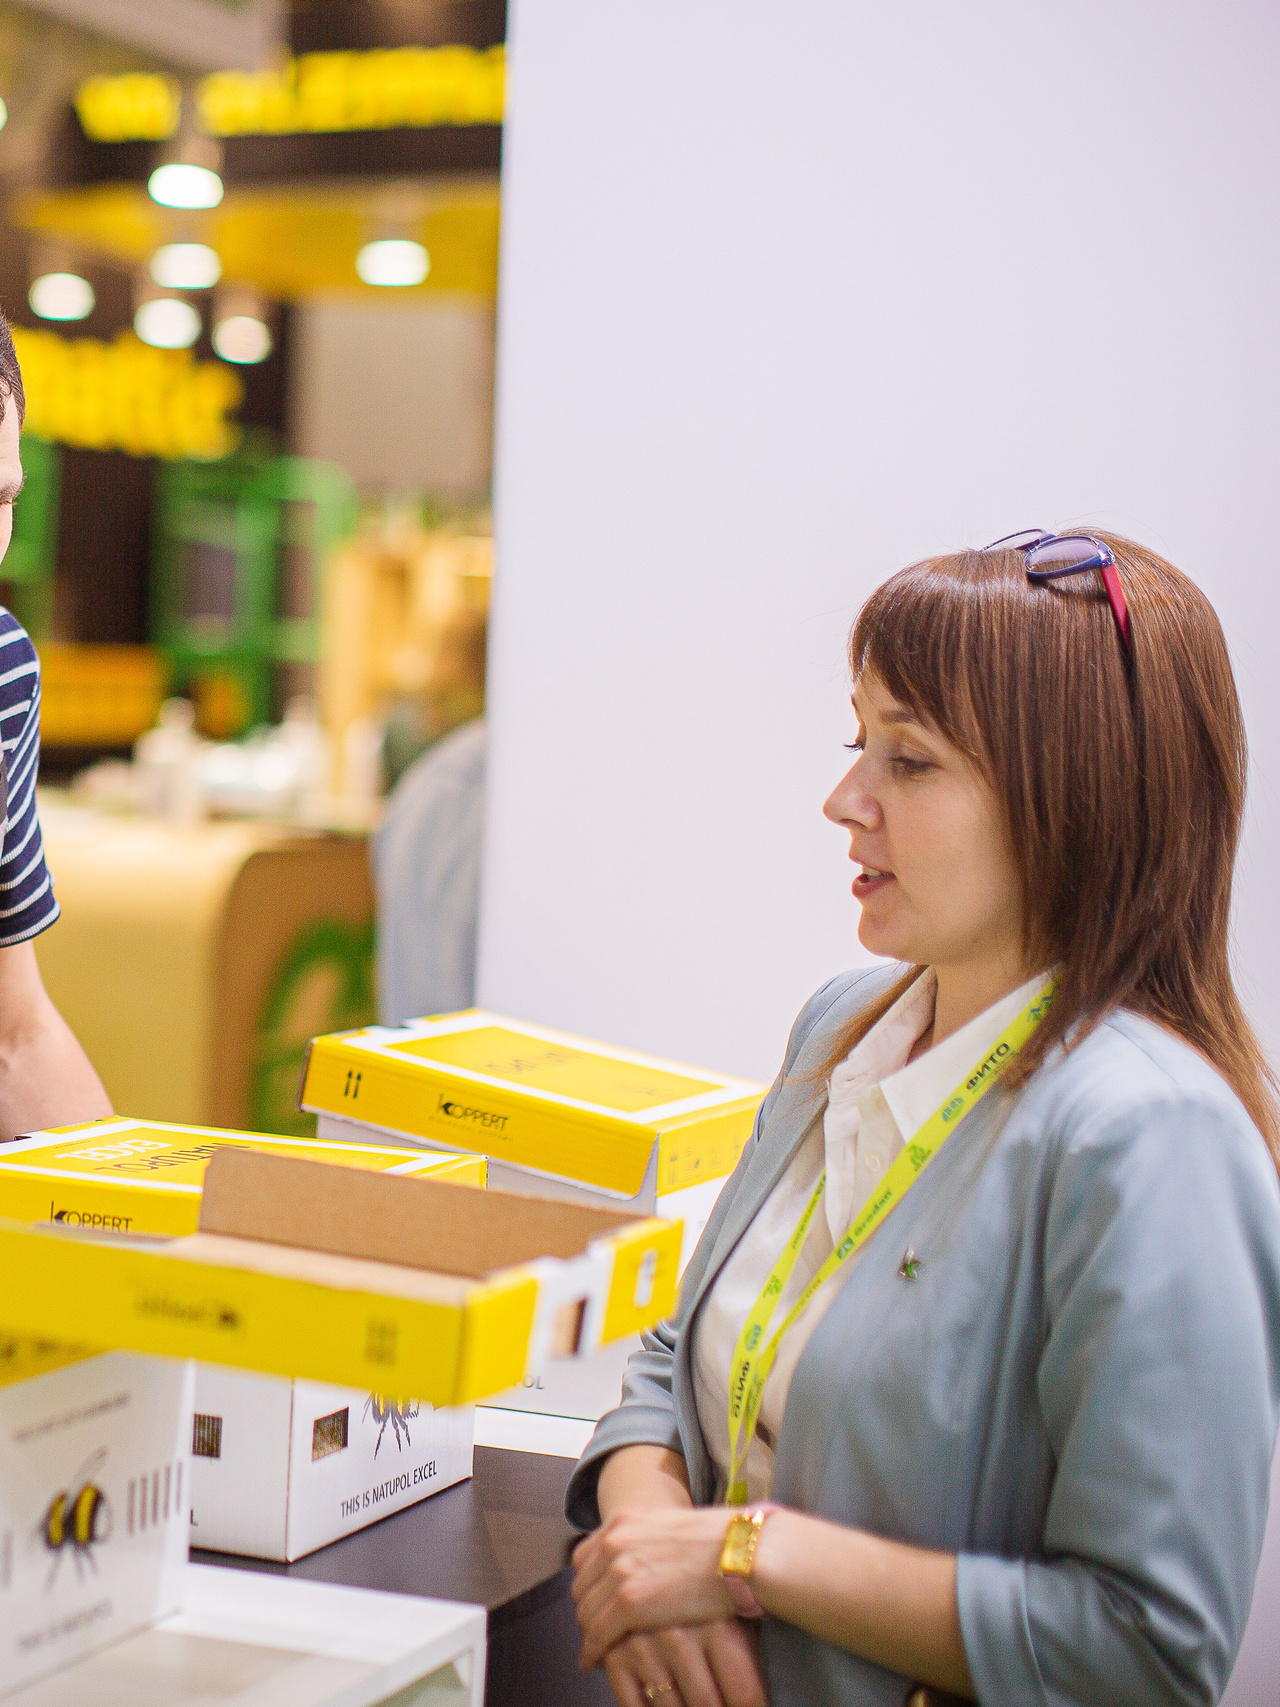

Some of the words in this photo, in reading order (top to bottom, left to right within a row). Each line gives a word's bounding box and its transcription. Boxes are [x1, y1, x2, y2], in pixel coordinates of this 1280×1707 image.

[966, 1042, 1010, 1090] ФИТО
[436, 1093, 509, 1131] KOPPERT
[53, 1138, 174, 1162] EXCEL
[50, 1200, 134, 1233] KOPPERT
[341, 1495, 360, 1518] THIS
[362, 1490, 370, 1509] IS
[372, 1472, 411, 1505] NATUPOL
[413, 1460, 437, 1485] EXCEL
